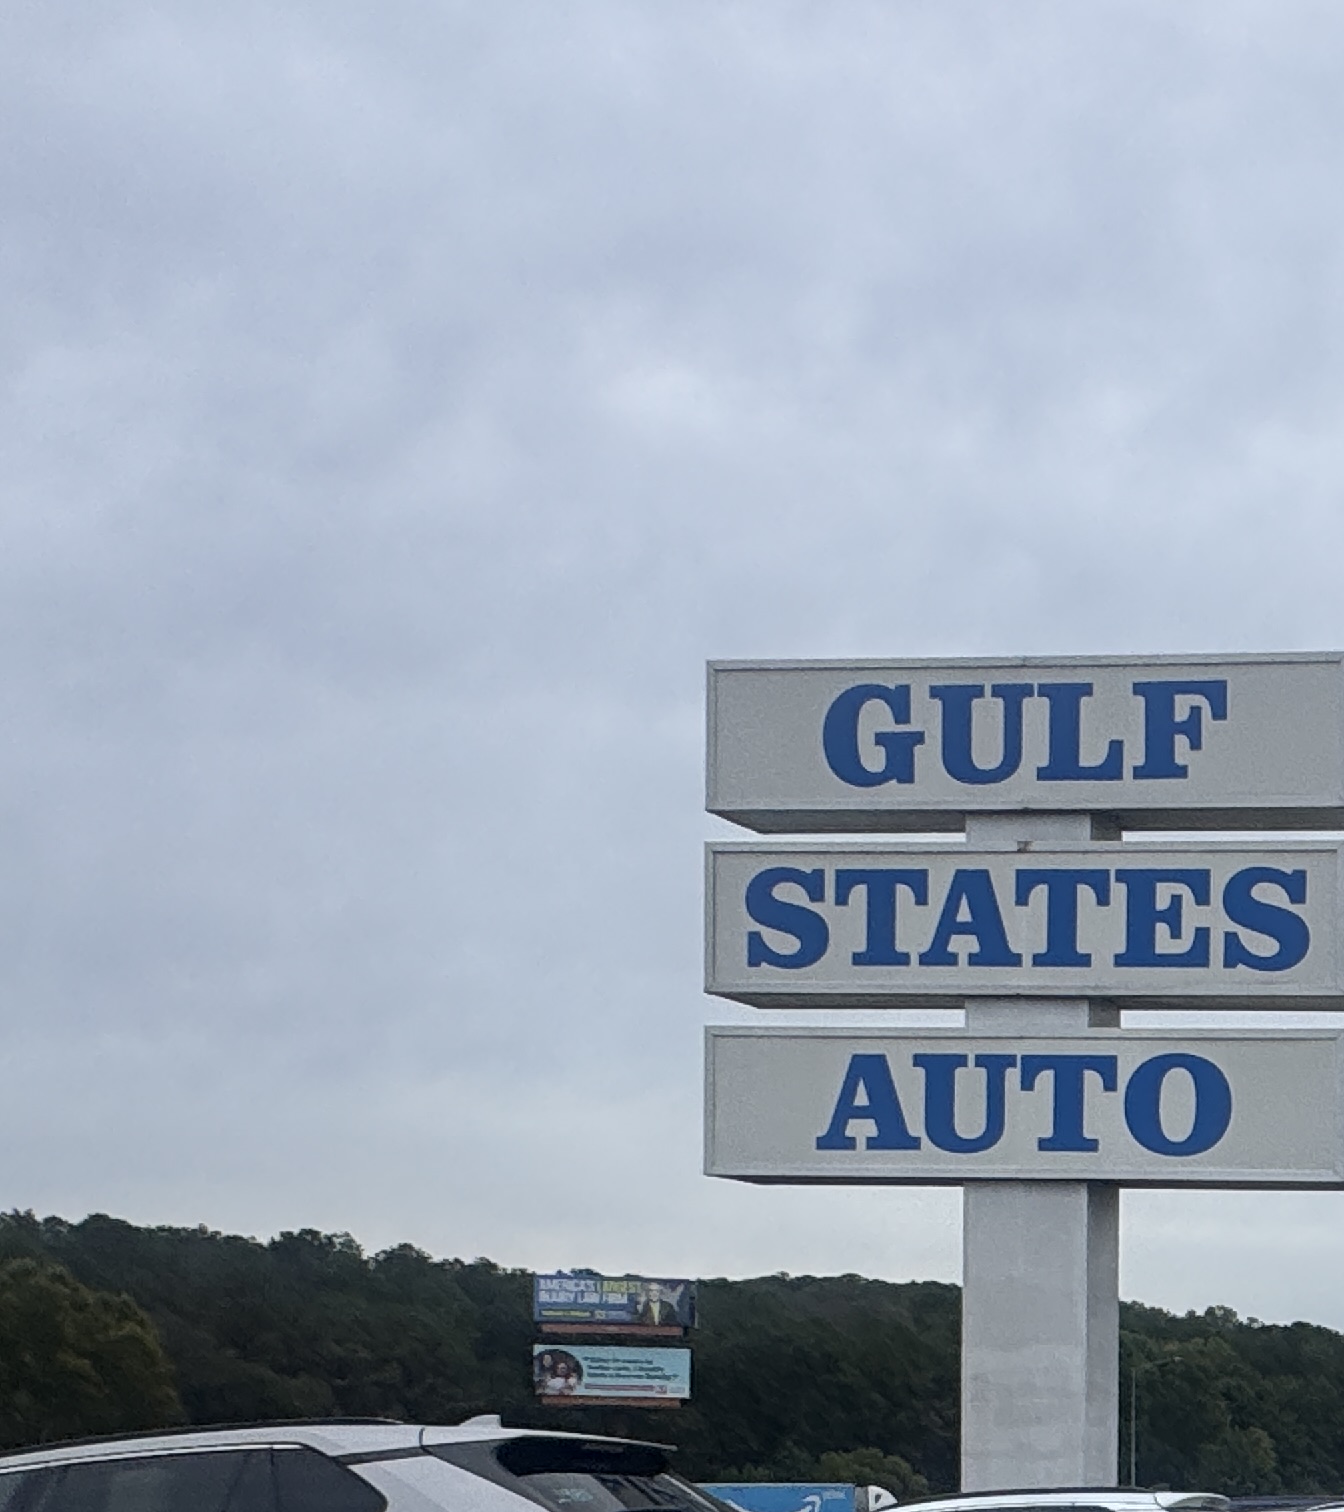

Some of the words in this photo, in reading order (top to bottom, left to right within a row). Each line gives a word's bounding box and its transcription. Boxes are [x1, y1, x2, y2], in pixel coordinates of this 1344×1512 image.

[822, 679, 1228, 788] GULF
[744, 866, 1311, 972] STATES
[815, 1052, 1232, 1157] AUTO
